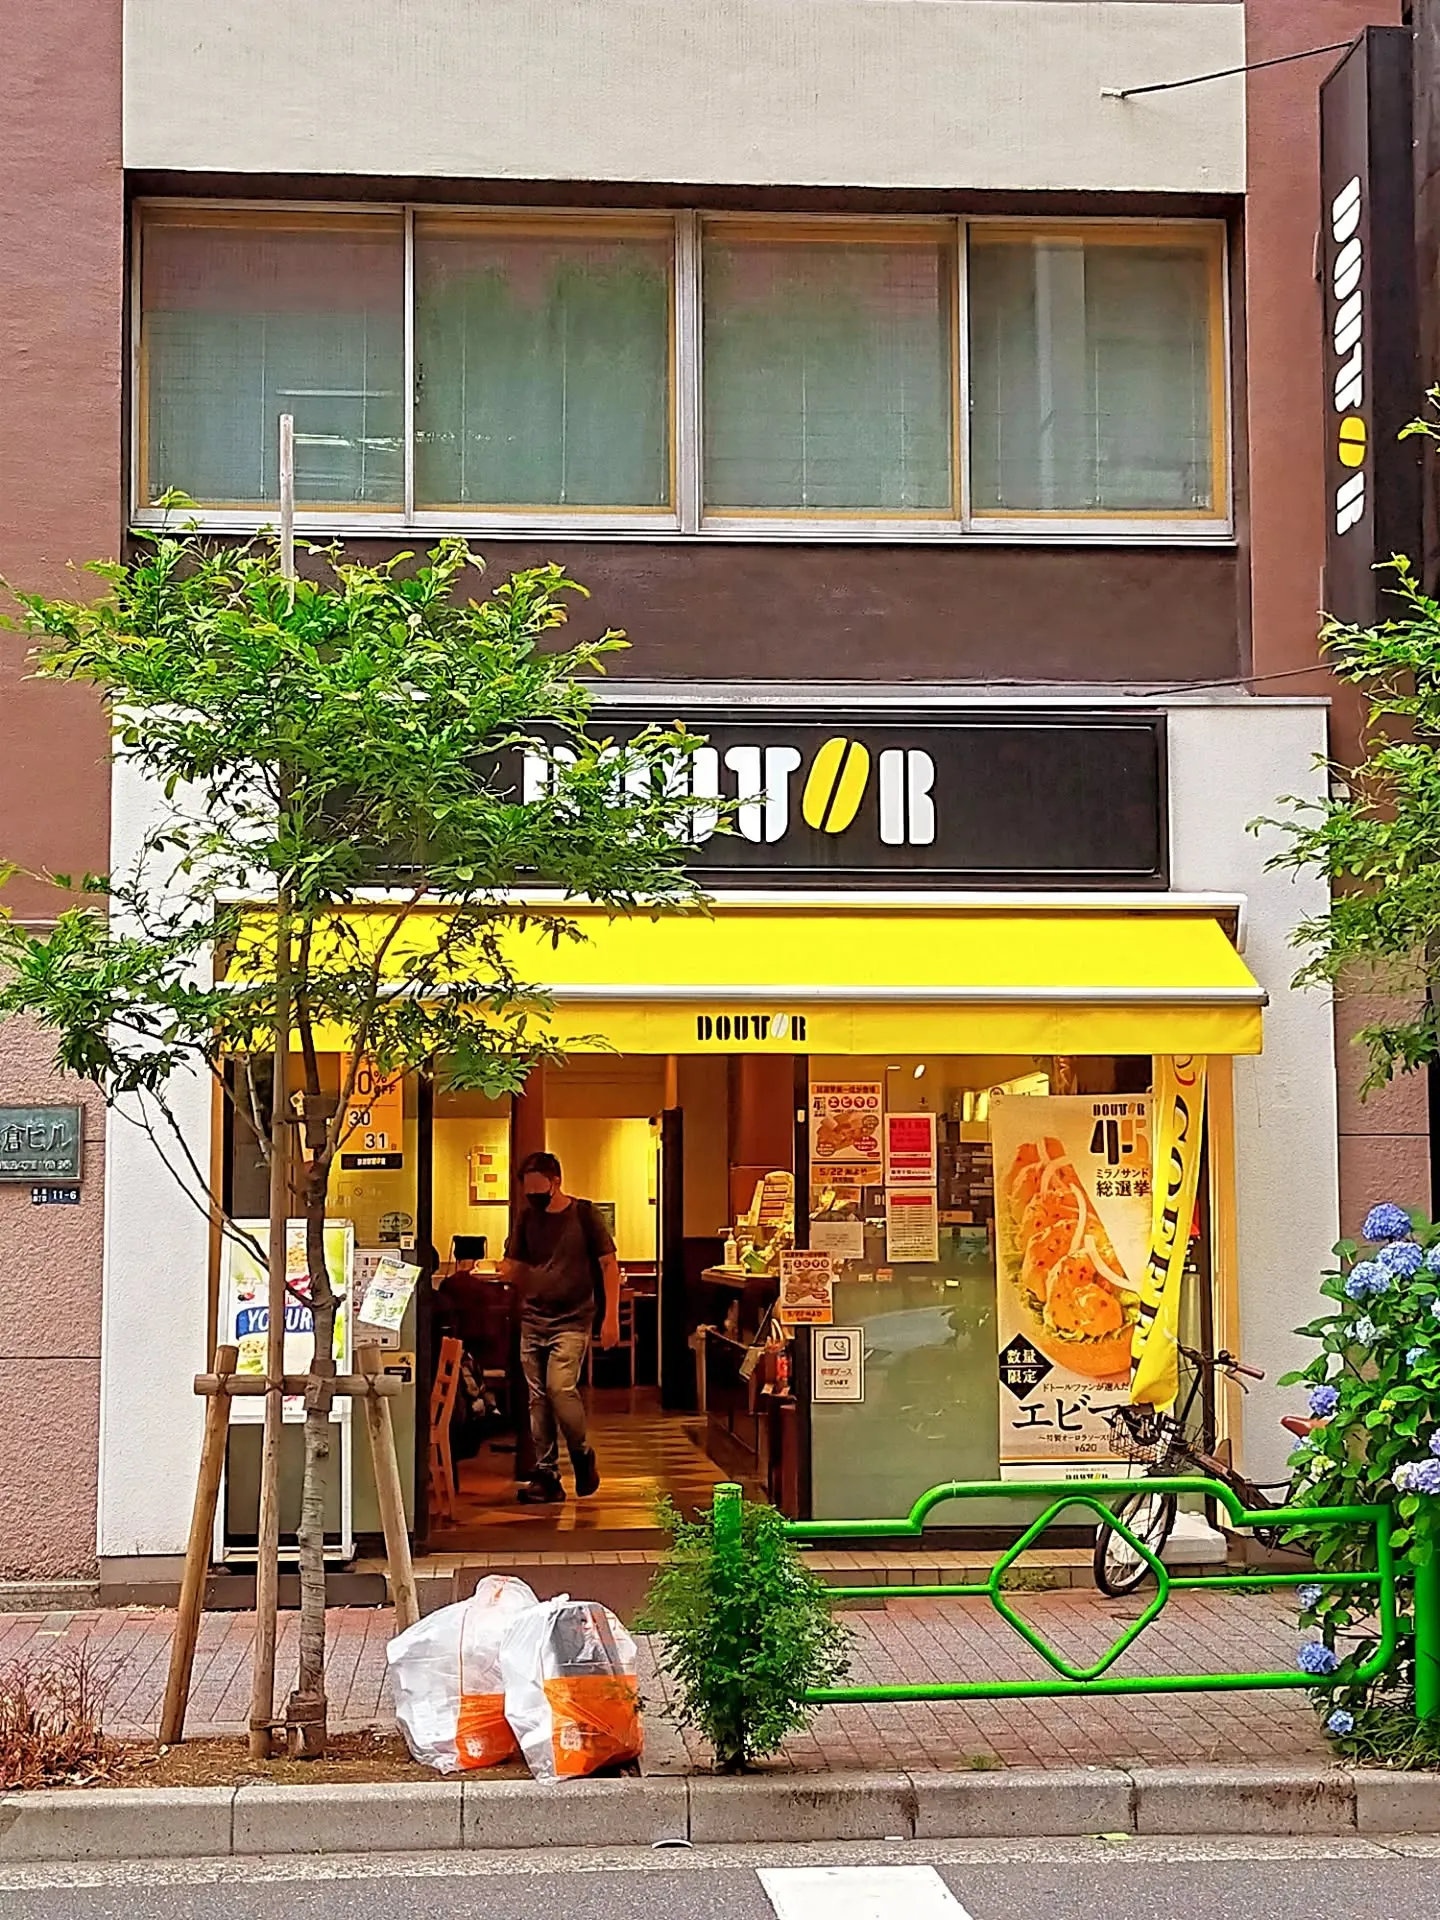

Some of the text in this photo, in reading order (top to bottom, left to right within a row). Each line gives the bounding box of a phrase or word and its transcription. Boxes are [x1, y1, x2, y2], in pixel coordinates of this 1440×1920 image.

[1332, 176, 1367, 536] DOUTOR
[697, 1012, 806, 1041] DOUTOR
[1093, 1103, 1145, 1116] DOUTOR
[349, 1110, 371, 1126] 30
[365, 1133, 386, 1149] 31
[1096, 1168, 1149, 1179] ミラノサンド
[52, 1190, 77, 1200] 11-6
[1096, 1180, 1151, 1197] 総選挙
[1131, 1094, 1190, 1390] COFFE
[247, 1308, 313, 1332] YOUR
[1007, 1350, 1037, 1364] 数量
[1007, 1369, 1038, 1384] 限定
[1074, 1443, 1097, 1453] ¥620
